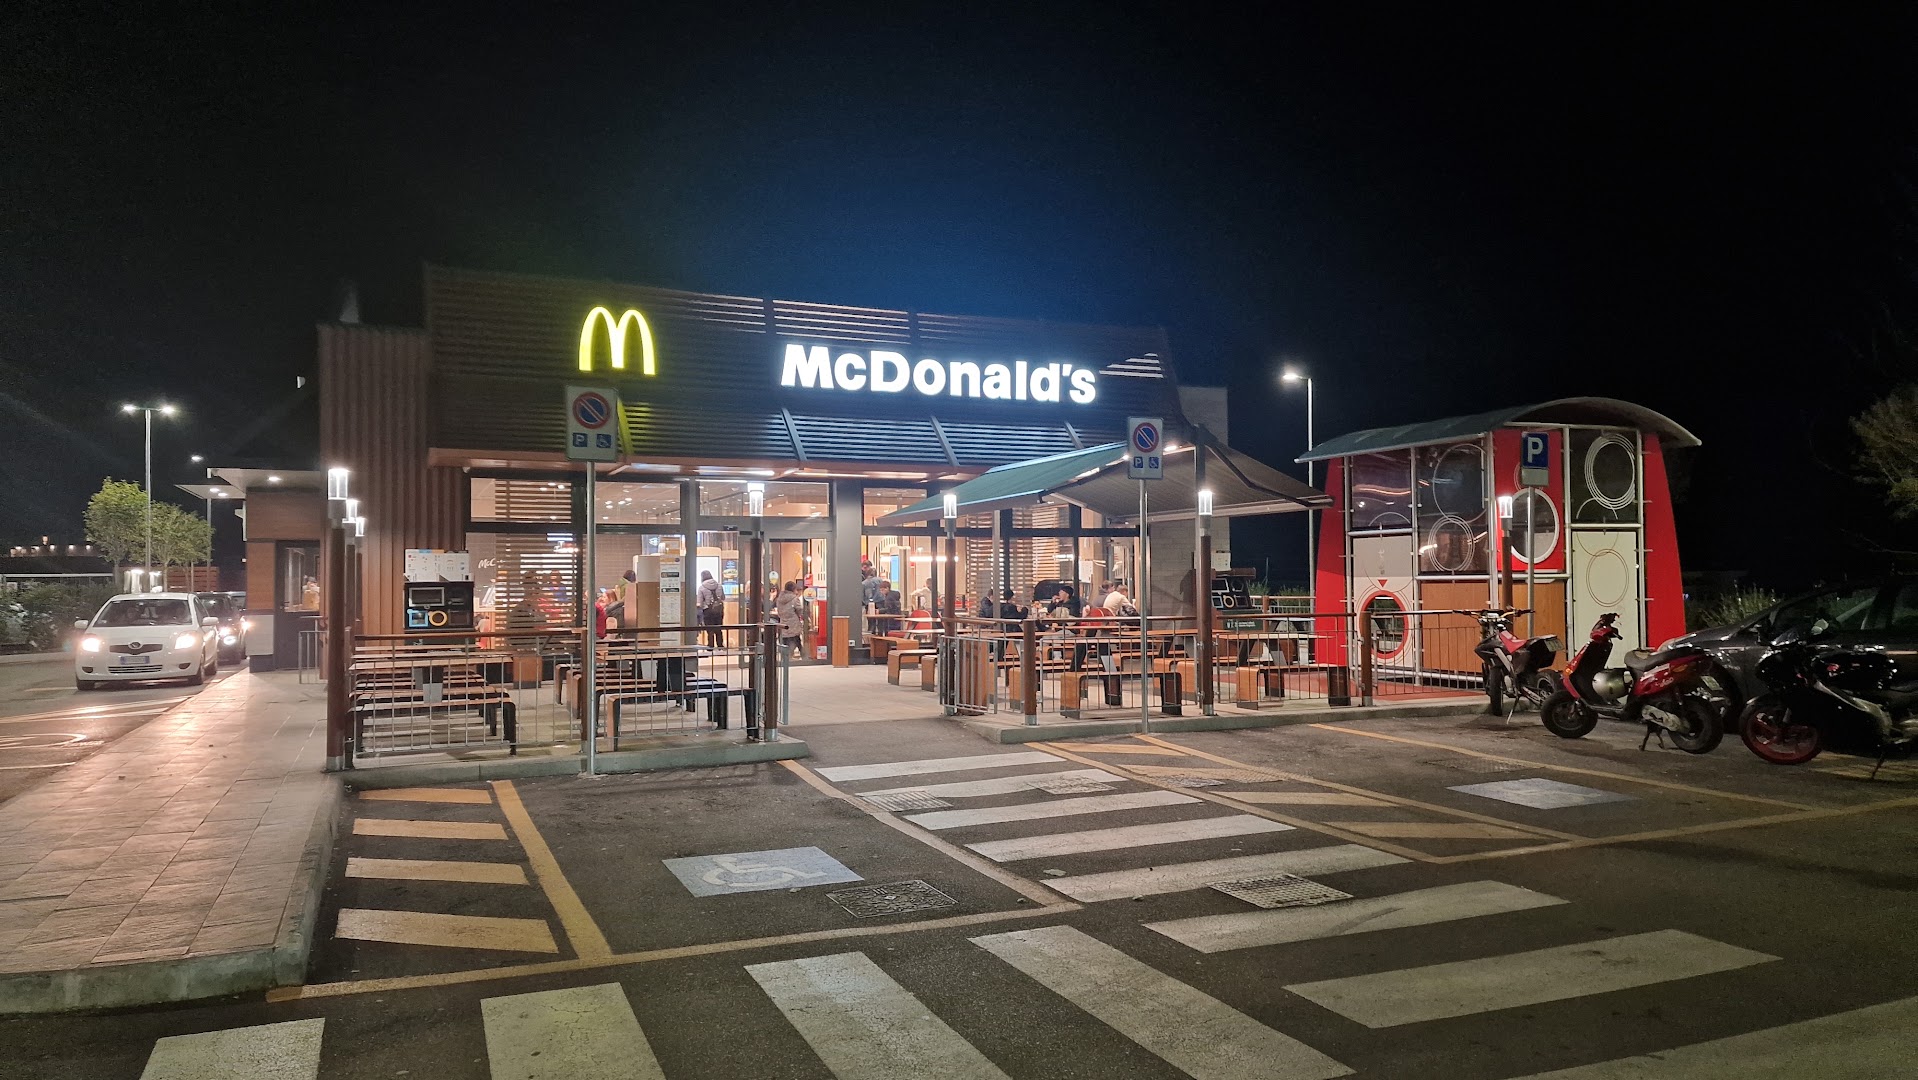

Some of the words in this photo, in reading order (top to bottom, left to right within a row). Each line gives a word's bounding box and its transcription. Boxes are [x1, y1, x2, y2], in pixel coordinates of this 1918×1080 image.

[779, 342, 1097, 405] McDonald's
[575, 434, 585, 446] P
[1527, 436, 1544, 464] P
[1135, 457, 1142, 467] P
